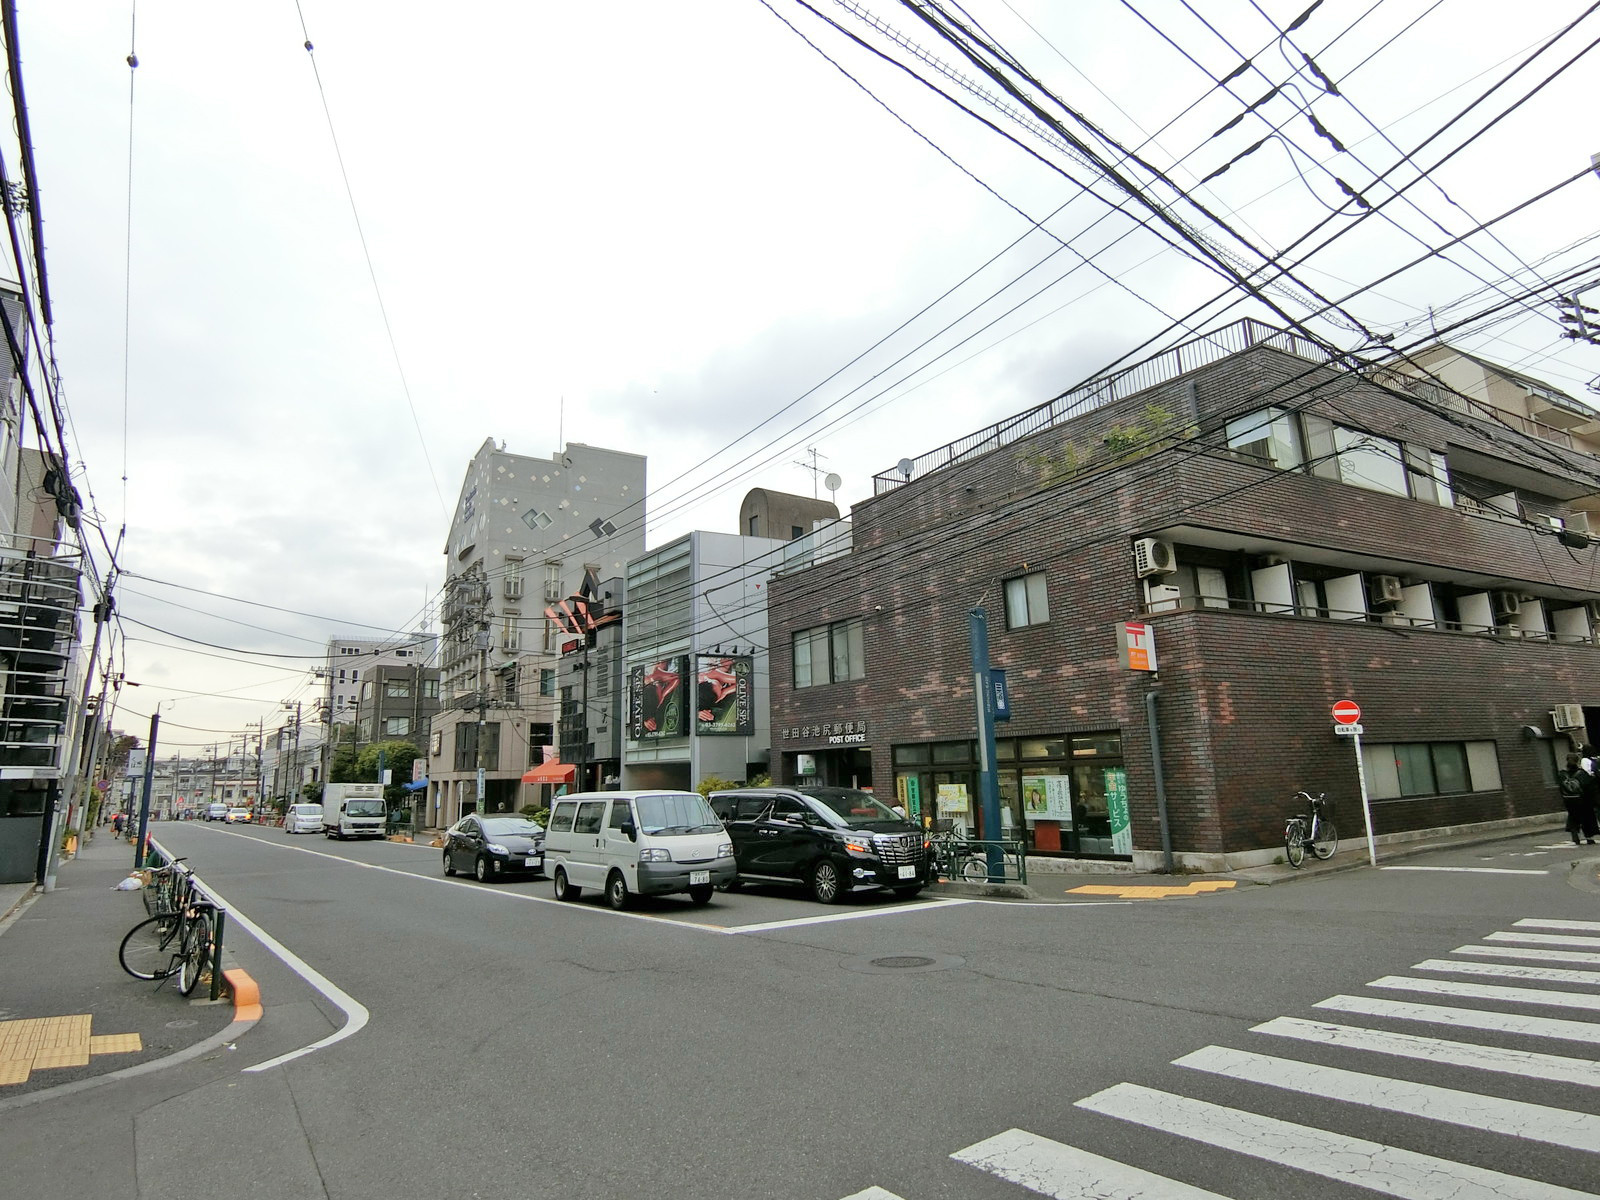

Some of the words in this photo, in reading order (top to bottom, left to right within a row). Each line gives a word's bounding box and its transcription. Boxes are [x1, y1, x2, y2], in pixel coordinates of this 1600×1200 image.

[634, 669, 642, 692] SPA
[738, 678, 747, 707] OLIVE
[634, 696, 642, 738] OLIVE
[739, 709, 747, 726] SPA
[782, 721, 866, 740] 世田谷池尻郵便局
[829, 735, 843, 744] POST
[844, 734, 866, 743] OFFICE
[1107, 773, 1121, 827] 年金サービス
